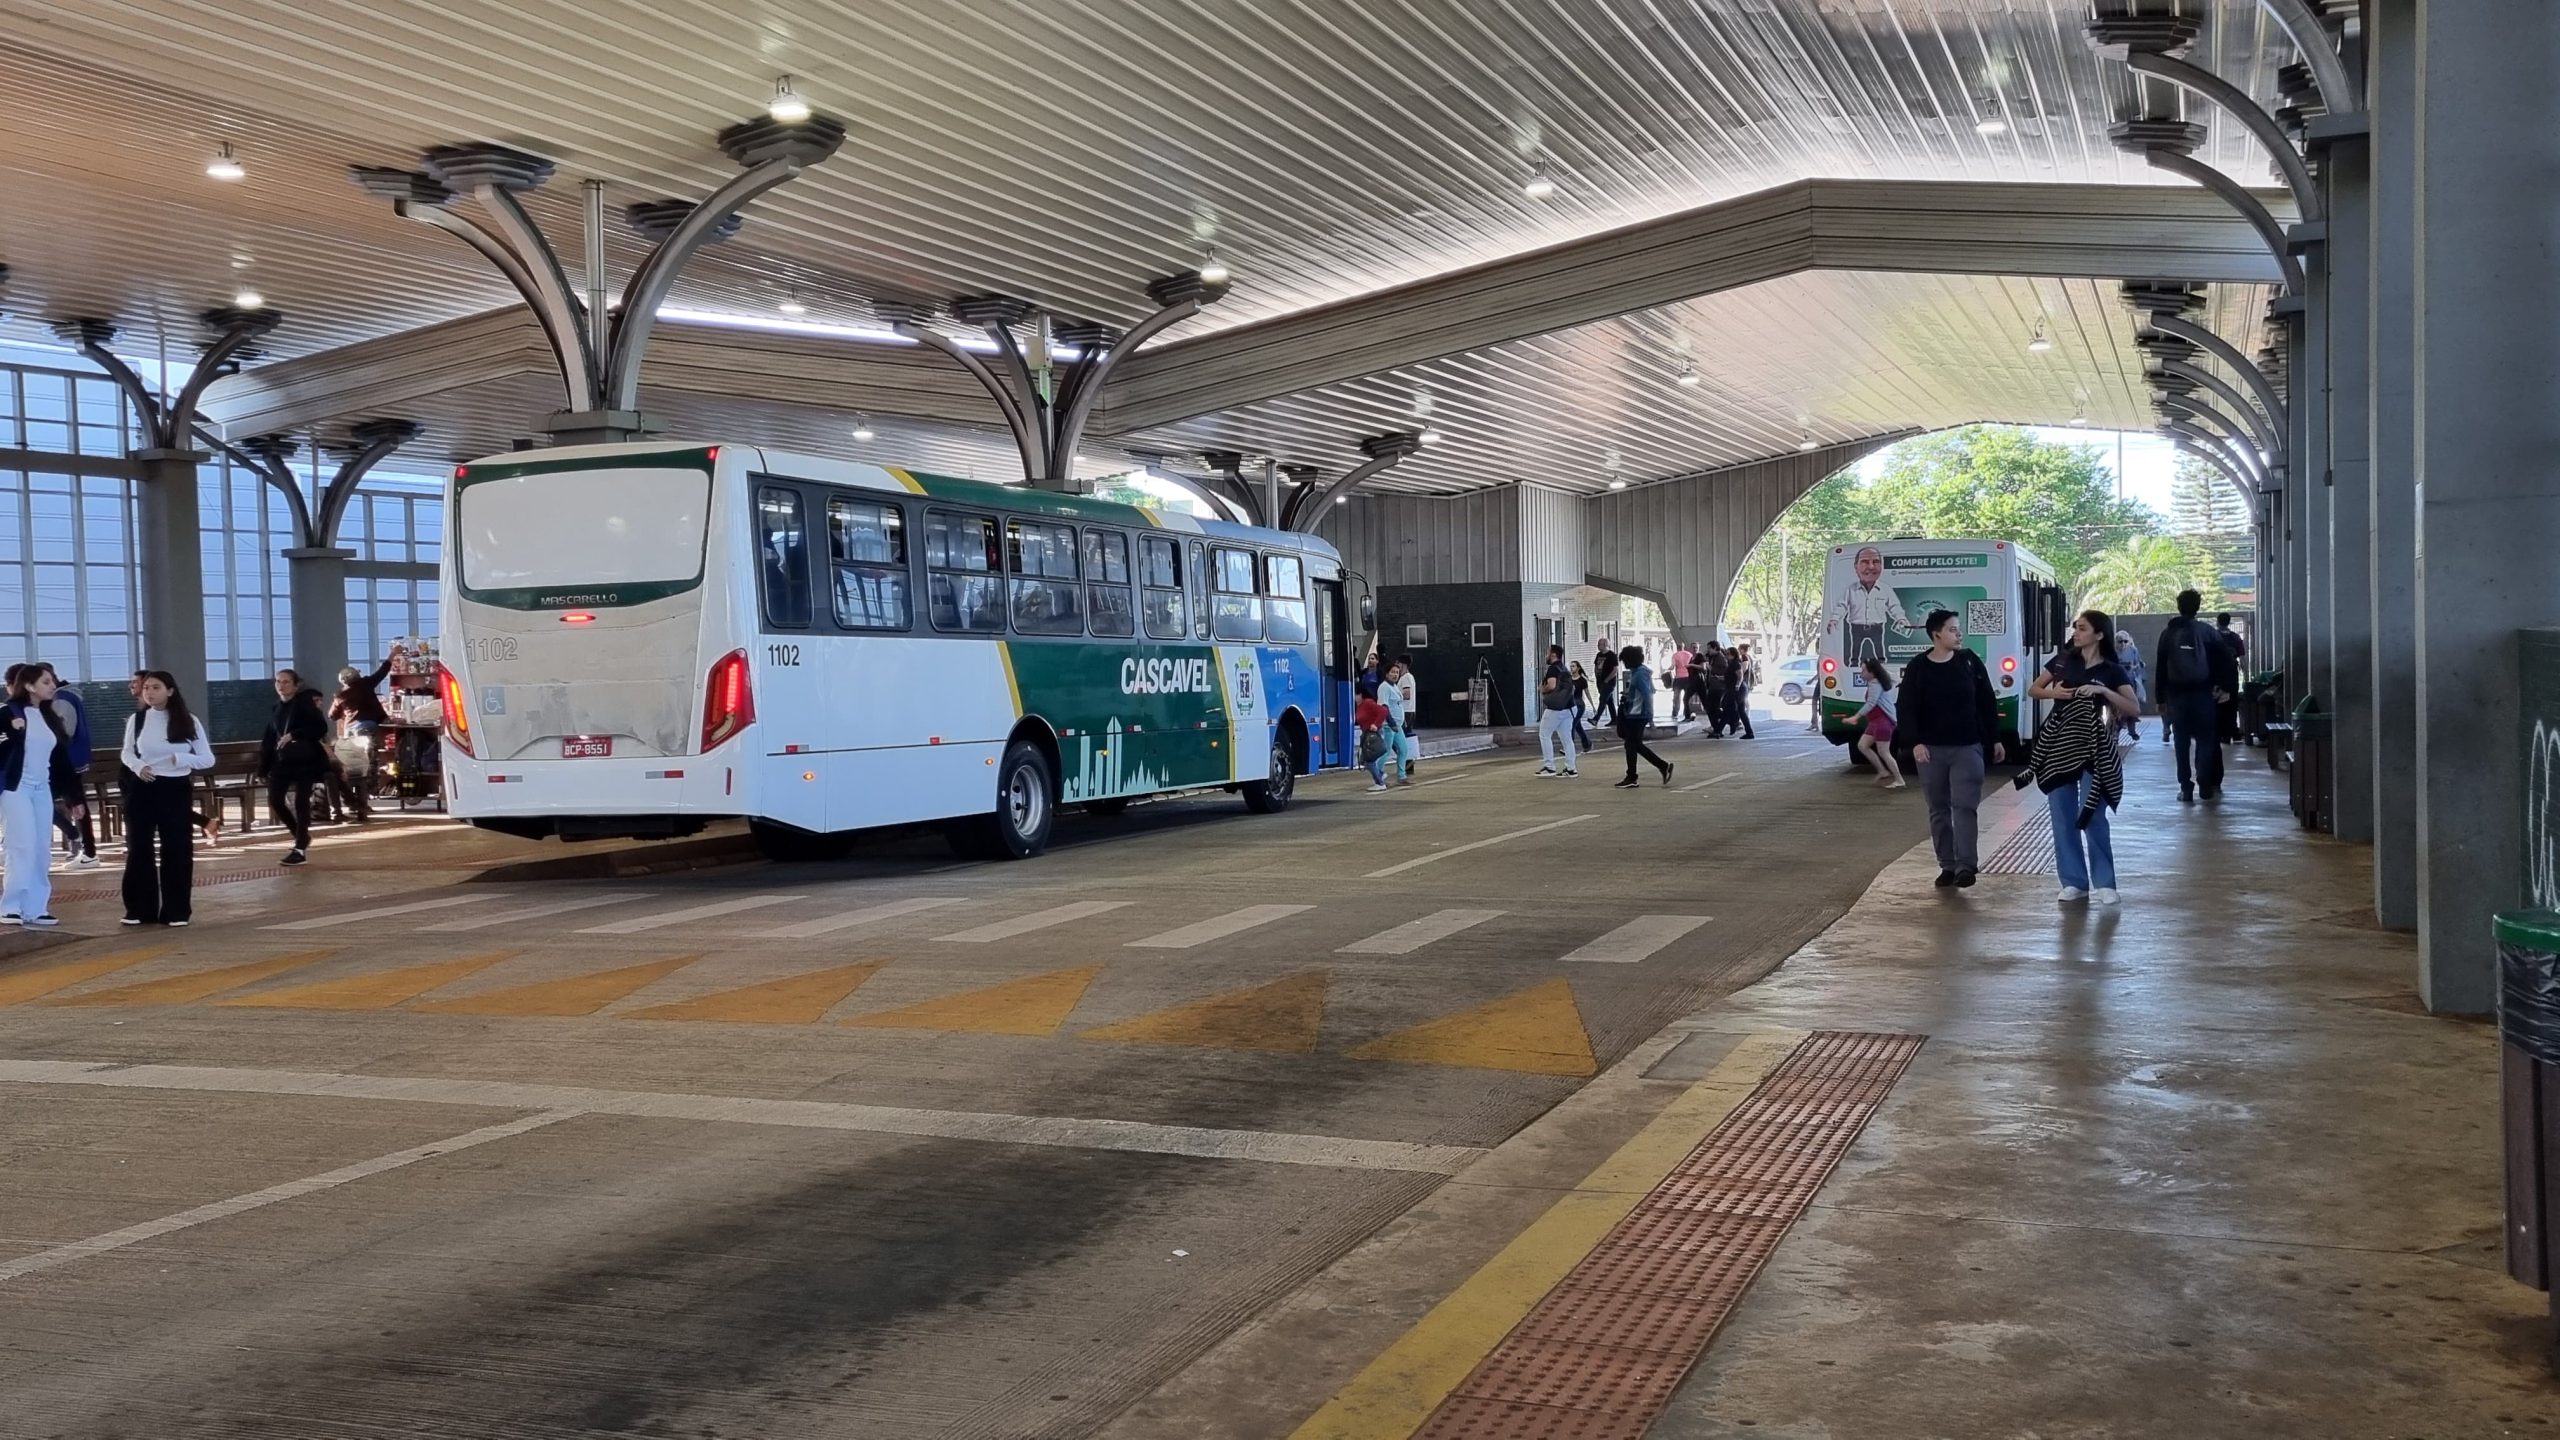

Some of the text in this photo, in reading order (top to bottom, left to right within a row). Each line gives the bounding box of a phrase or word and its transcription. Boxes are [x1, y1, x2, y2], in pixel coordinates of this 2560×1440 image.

[1891, 556, 1978, 567] COMPRE PELO SITE!
[541, 593, 618, 605] MASCARELLO
[466, 636, 518, 662] 1102
[768, 644, 800, 667] 1102
[1274, 658, 1290, 673] 1102
[1121, 657, 1212, 694] CASCAVEL
